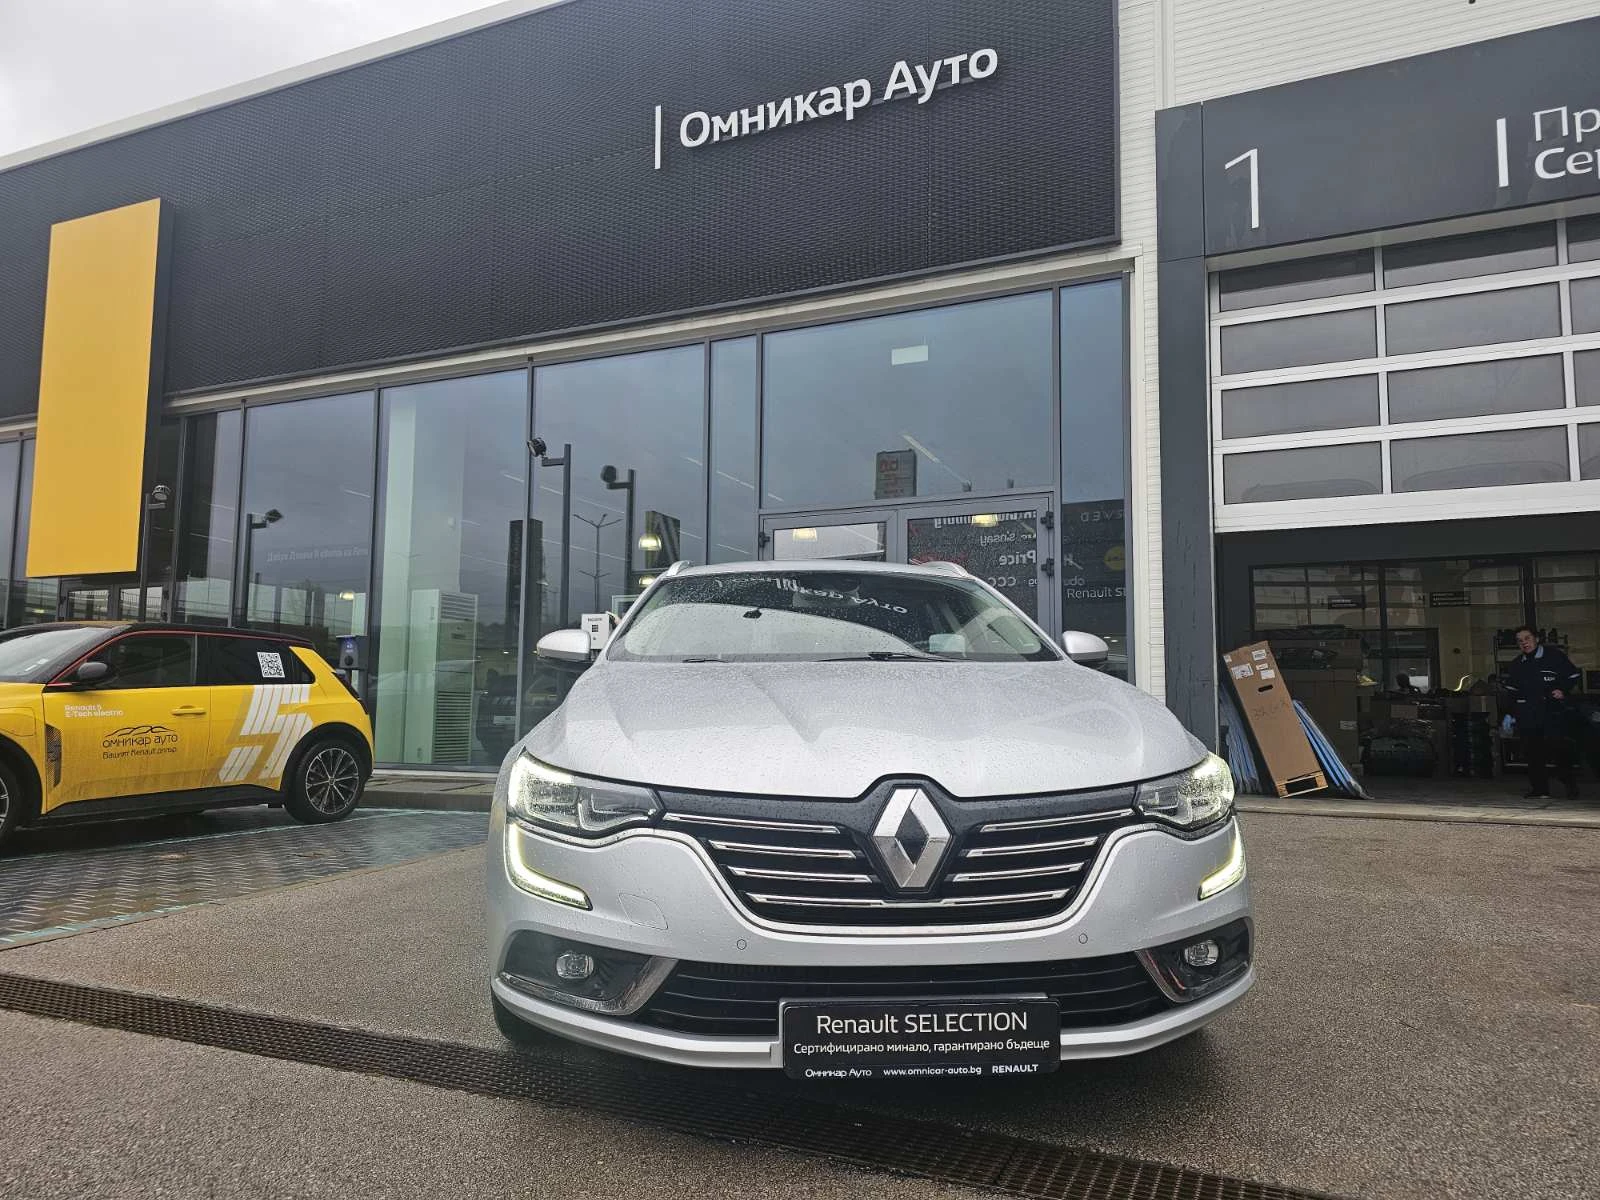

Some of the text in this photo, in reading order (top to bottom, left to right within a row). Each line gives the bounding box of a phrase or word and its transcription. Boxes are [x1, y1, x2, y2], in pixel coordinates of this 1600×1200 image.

[680, 48, 998, 147] Омникар Ауто
[1533, 106, 1600, 143] Пр
[1225, 148, 1259, 228] 1
[1067, 587, 1112, 598] Renault
[817, 1011, 1028, 1034] Renault SELECTION
[793, 1038, 1050, 1055] Сертифицирано минало, гарантирано бъдеще
[805, 1067, 872, 1078] Омникар Ауто
[883, 1066, 982, 1075] www.omnicar-auto.bg
[991, 1063, 1039, 1073] RENAULT
